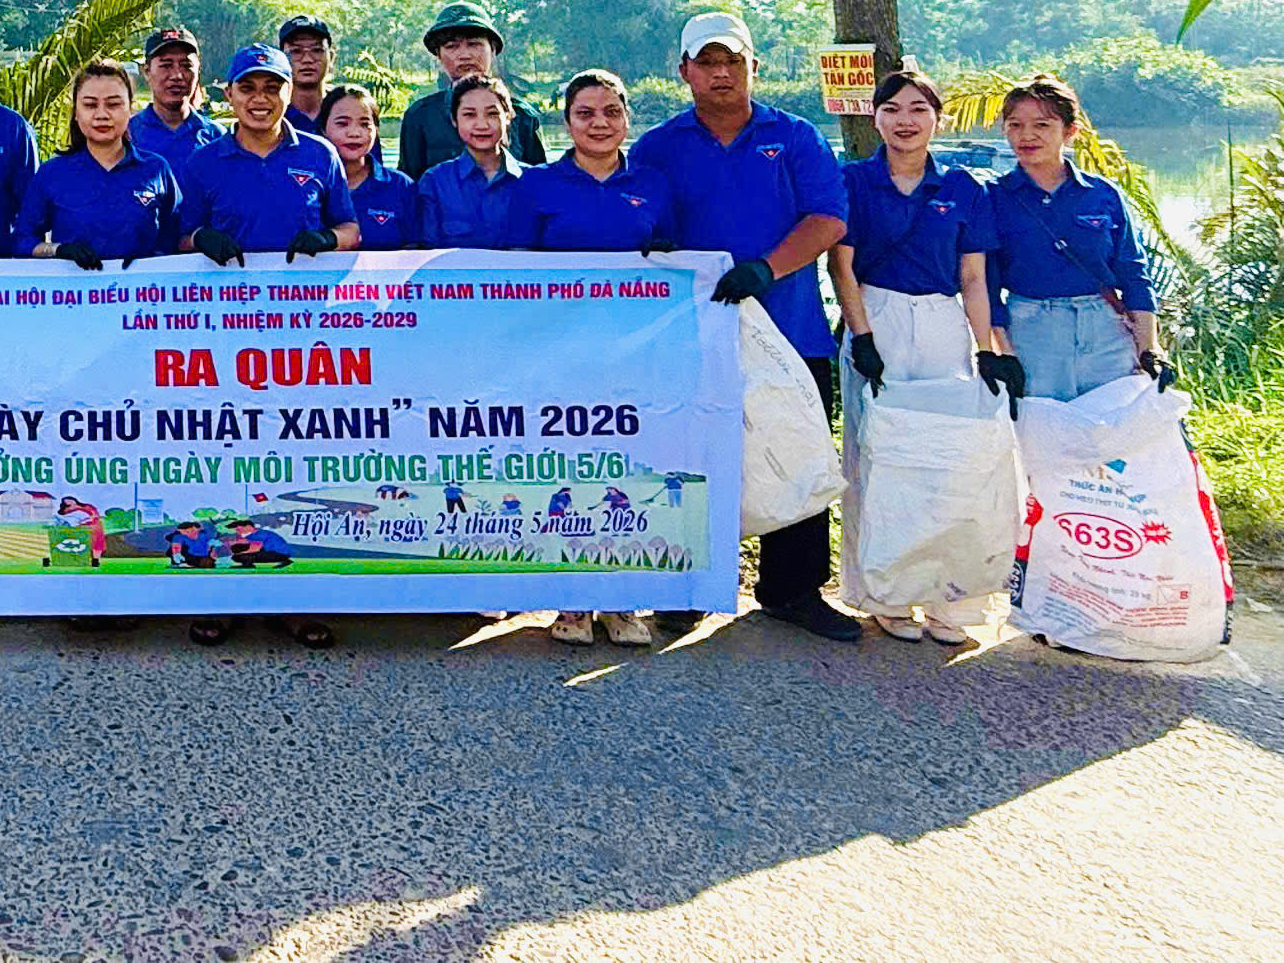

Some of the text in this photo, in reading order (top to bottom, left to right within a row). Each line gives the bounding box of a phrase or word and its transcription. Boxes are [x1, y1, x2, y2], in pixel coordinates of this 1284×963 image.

[16, 286, 46, 308] HỘI
[52, 289, 82, 308] ĐẠI
[88, 282, 129, 305] BIỂU
[135, 283, 166, 306] HỘI
[172, 283, 213, 302] LIÊN
[219, 283, 261, 304] HIỆP
[267, 285, 328, 302] THANH
[334, 281, 380, 301] NIÊN
[385, 281, 423, 303] VIỆT
[430, 284, 474, 300] NAM
[480, 280, 542, 300] THÀNH
[548, 278, 584, 299] PHỐ
[589, 279, 613, 298] ĐÀ
[122, 308, 417, 332] LẦN THỨ I, NHIỆM KỲ 2026-2029
[155, 341, 372, 391] RA QUÂN
[59, 398, 141, 441] CHỦ
[156, 401, 264, 448] NHẬT
[428, 398, 525, 437] NĂM
[540, 404, 640, 436] 2026
[139, 450, 222, 483] NGÀY
[234, 451, 293, 483] MÔI
[303, 449, 427, 483] TRƯỜNG
[437, 444, 494, 481] THẾ
[504, 446, 565, 480] GIỚI
[577, 451, 624, 480] 5/6
[292, 510, 649, 542] Hội An, ngày 24 tháng 5 năm 2026
